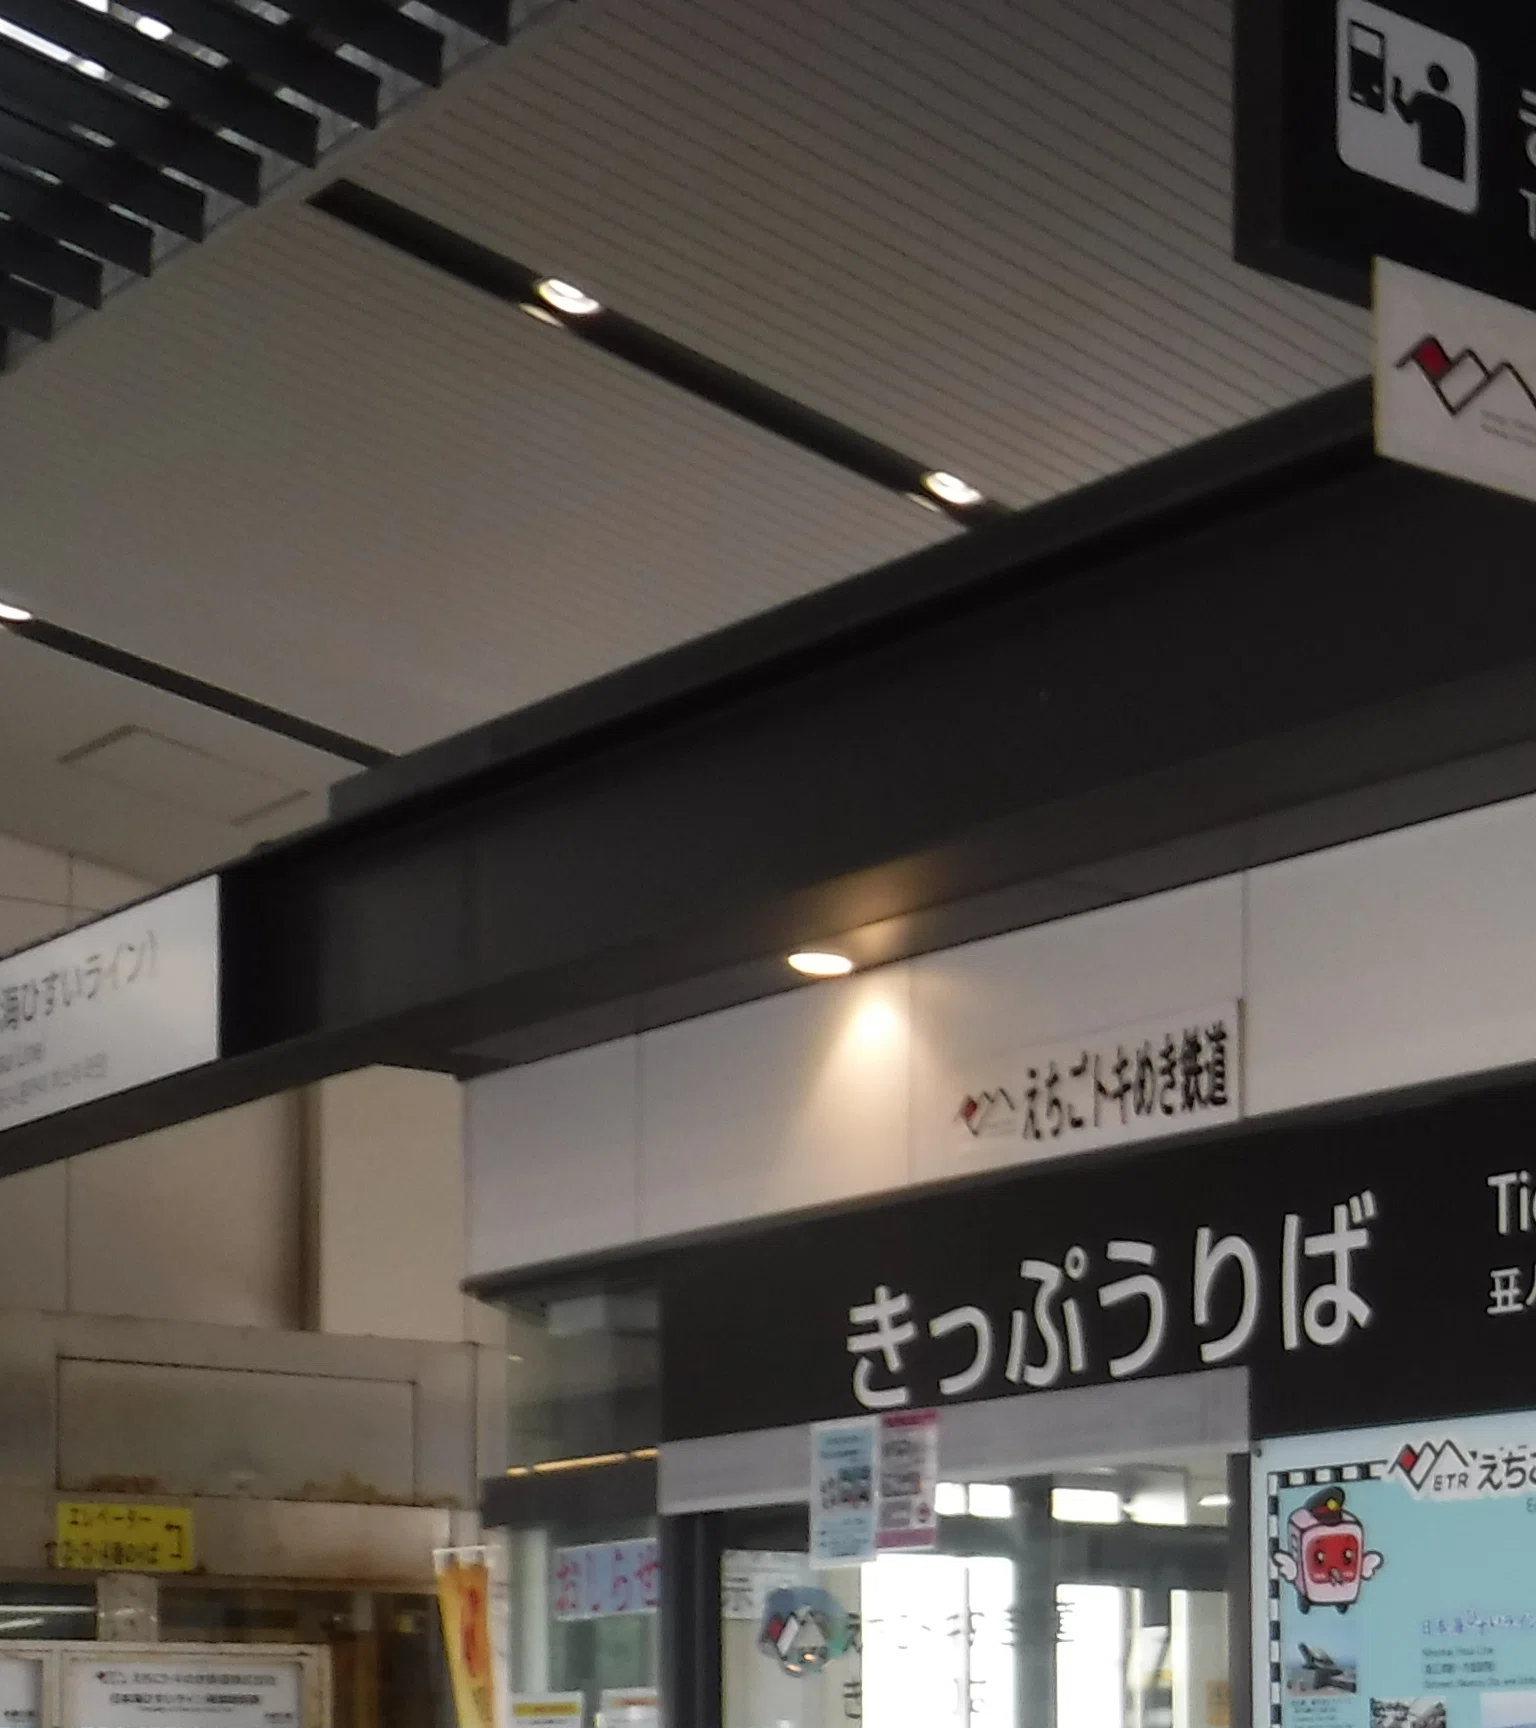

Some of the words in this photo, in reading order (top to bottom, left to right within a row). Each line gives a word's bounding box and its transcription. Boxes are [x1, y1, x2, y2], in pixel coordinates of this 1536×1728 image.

[1021, 1023, 1229, 1143] えちごトキめき鉄道
[845, 1190, 1378, 1407] きっぷうりば
